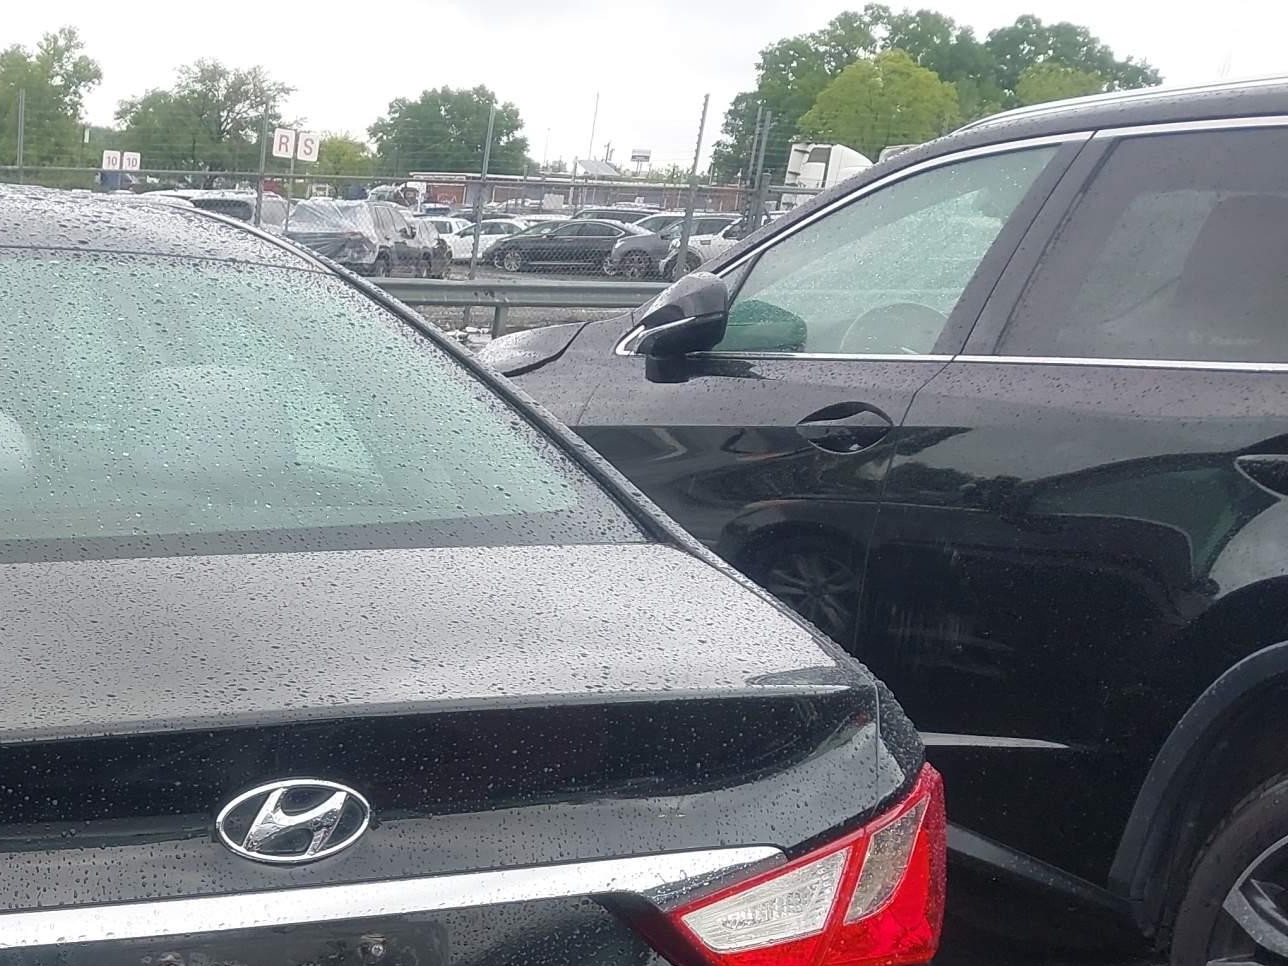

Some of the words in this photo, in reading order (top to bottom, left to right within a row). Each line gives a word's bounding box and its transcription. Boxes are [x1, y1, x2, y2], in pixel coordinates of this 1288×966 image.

[278, 134, 290, 153] R
[303, 138, 315, 156] S
[106, 156, 118, 167] 10
